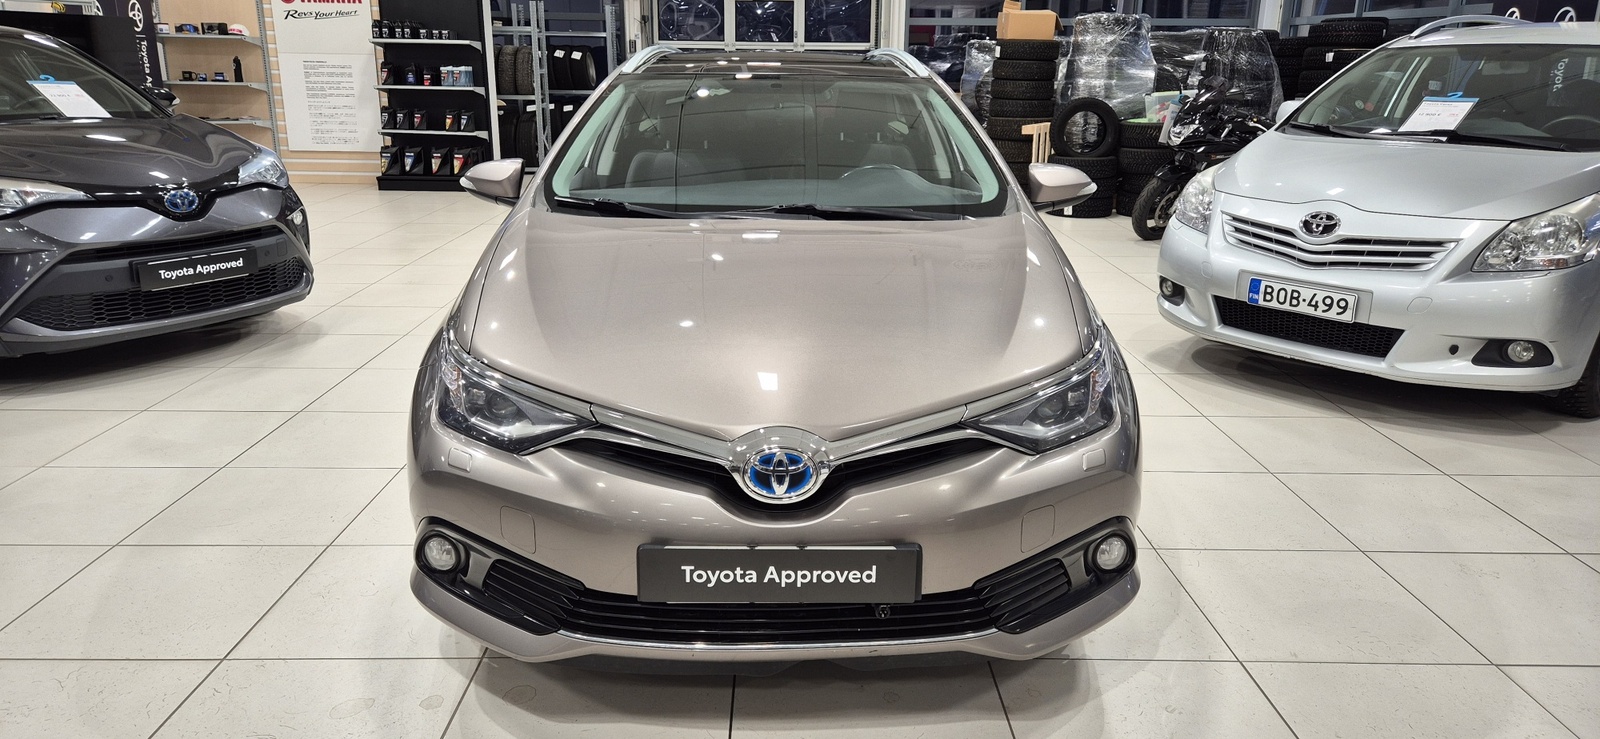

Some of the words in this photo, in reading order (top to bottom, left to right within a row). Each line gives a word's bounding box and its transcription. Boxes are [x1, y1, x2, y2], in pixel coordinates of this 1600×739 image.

[283, 9, 313, 20] Revs
[314, 10, 335, 20] Your
[335, 9, 359, 17] Heart
[140, 40, 150, 74] Toyota
[1552, 57, 1569, 92] Toyot
[159, 267, 194, 280] Toyota
[196, 257, 244, 275] Approved
[1249, 292, 1259, 300] FIN
[1262, 284, 1349, 316] BOB-499
[681, 565, 757, 587] Toyota
[763, 565, 877, 587] Approved
